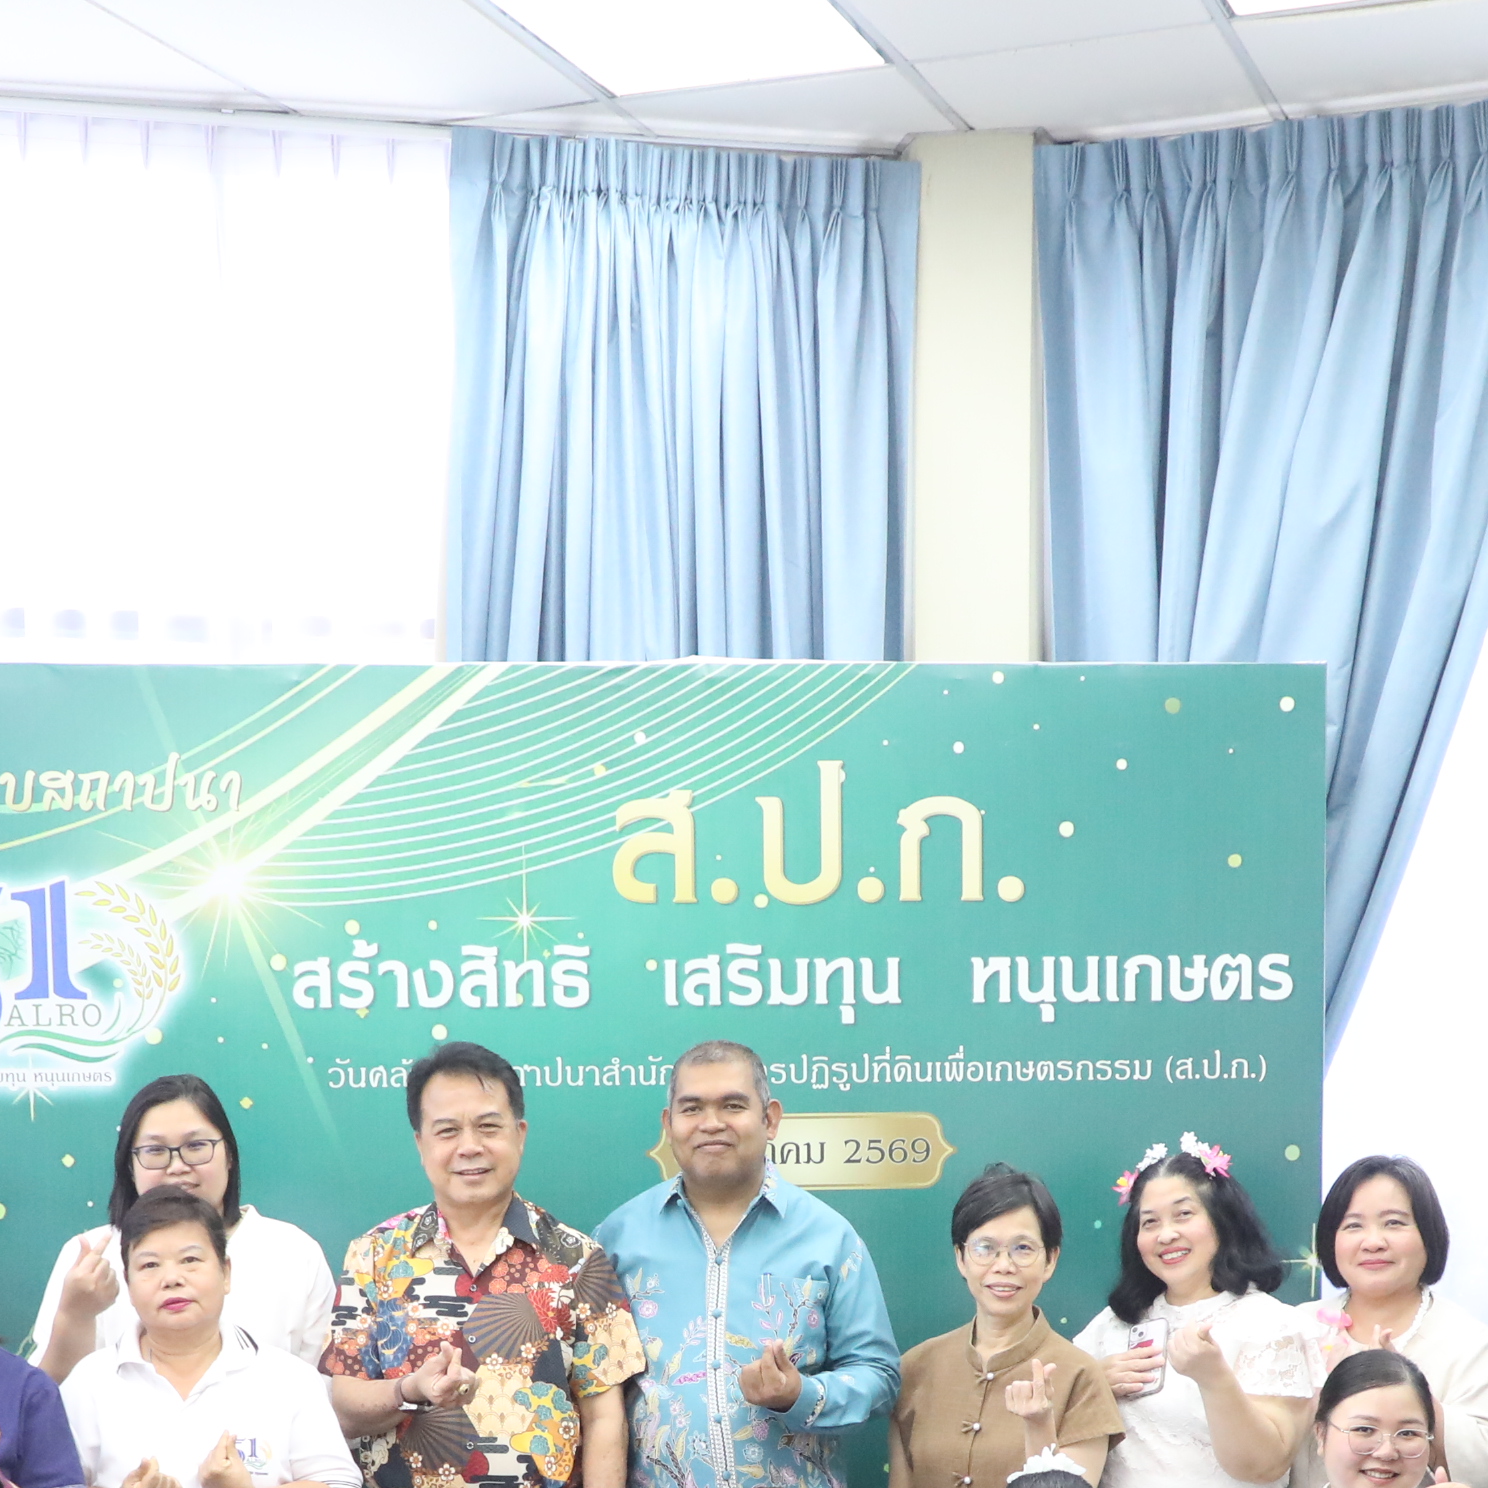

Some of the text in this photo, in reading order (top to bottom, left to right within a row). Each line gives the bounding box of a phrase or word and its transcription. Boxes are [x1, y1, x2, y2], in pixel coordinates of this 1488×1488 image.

[612, 760, 1025, 905] ส.ป.ก.
[291, 939, 1294, 1025] สร้างสิทธิ เสริมทุน หนุนเกษตร
[4, 1003, 102, 1027] ALRO
[33, 1070, 113, 1087] หนุนเกษตร
[1165, 1049, 1267, 1083] (ส.ป.ก.)
[843, 1137, 931, 1165] 2569
